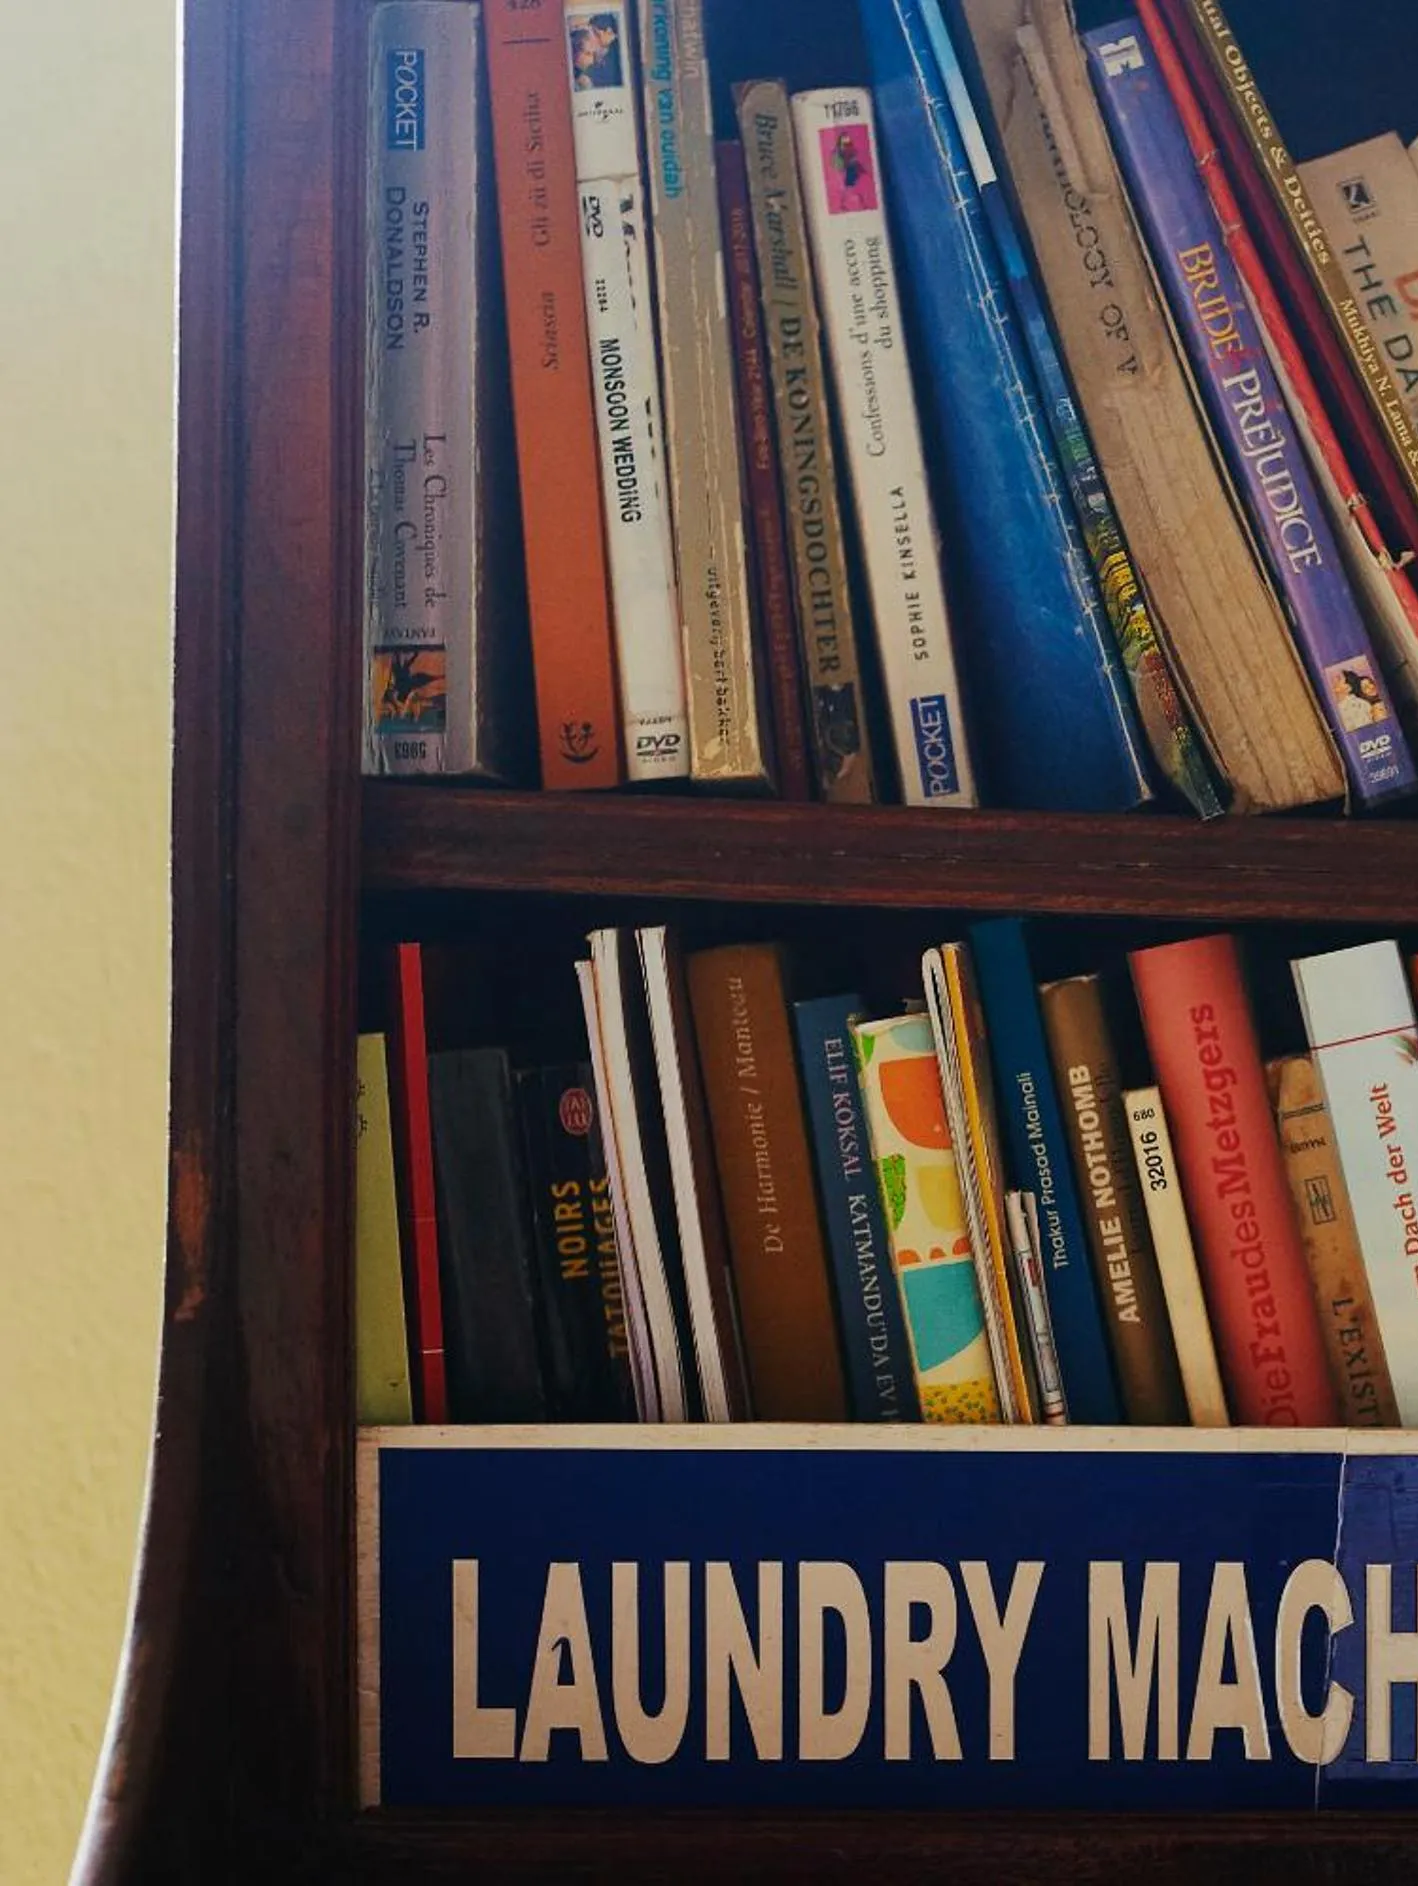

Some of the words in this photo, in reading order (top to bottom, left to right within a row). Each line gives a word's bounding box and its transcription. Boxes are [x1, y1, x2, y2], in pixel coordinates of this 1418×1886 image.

[391, 51, 419, 150] POCKET
[521, 91, 544, 152] Sicilia
[656, 88, 676, 125] van
[525, 160, 545, 180] di
[659, 129, 684, 200] ouidah
[754, 112, 779, 181] Bruce
[1224, 44, 1275, 140] Objects
[1268, 145, 1289, 170] &
[1283, 176, 1331, 265] Deities
[413, 201, 430, 302] STEPHEN
[530, 216, 552, 248] Gli
[586, 195, 606, 240] DVD
[763, 188, 798, 291] Marshall
[386, 186, 406, 350] DONALDSON
[843, 238, 861, 288] accro
[864, 236, 891, 320] shopping
[1343, 234, 1399, 321] THE
[413, 312, 430, 334] R.
[538, 291, 559, 371] Sciascia
[779, 317, 804, 359] DE
[847, 292, 870, 346] d'une
[872, 323, 893, 351] du
[1098, 302, 1131, 344] OF
[599, 338, 628, 433] MONSOON
[859, 348, 886, 459] Confessions
[1177, 240, 1245, 362] BRIDE
[1222, 366, 1324, 575] PREJUDICE
[1339, 298, 1380, 375] Mukhiya
[1374, 374, 1392, 398] N.
[1385, 398, 1413, 449] Lama
[393, 439, 417, 513] Thomas
[423, 432, 447, 467] Les
[611, 436, 641, 524] WEDDING
[416, 474, 448, 580] Chroniques
[784, 367, 842, 675] KONINGSDOCHTER
[887, 485, 918, 582] KINSELLA
[393, 520, 416, 609] Covenant
[423, 587, 447, 609] de
[903, 591, 931, 663] SOPHIE
[636, 733, 682, 753] DVD
[914, 697, 957, 796] POCKET
[1357, 733, 1391, 756] DVD
[724, 975, 757, 1080] Manteau
[1015, 1071, 1044, 1139] Mainali
[1068, 1064, 1116, 1214] NOTHOMB
[1367, 1081, 1398, 1142] Welt
[738, 1100, 778, 1214] Harmonie
[1029, 1143, 1056, 1206] Prasad
[1137, 1131, 1169, 1192] 32016
[1383, 1144, 1409, 1185] der
[549, 1179, 590, 1281] NOIRS
[763, 1220, 785, 1255] De
[1041, 1209, 1071, 1271] Thakur
[1095, 1213, 1143, 1324] AMELIE
[451, 1557, 1046, 1766] LAUNDRY
